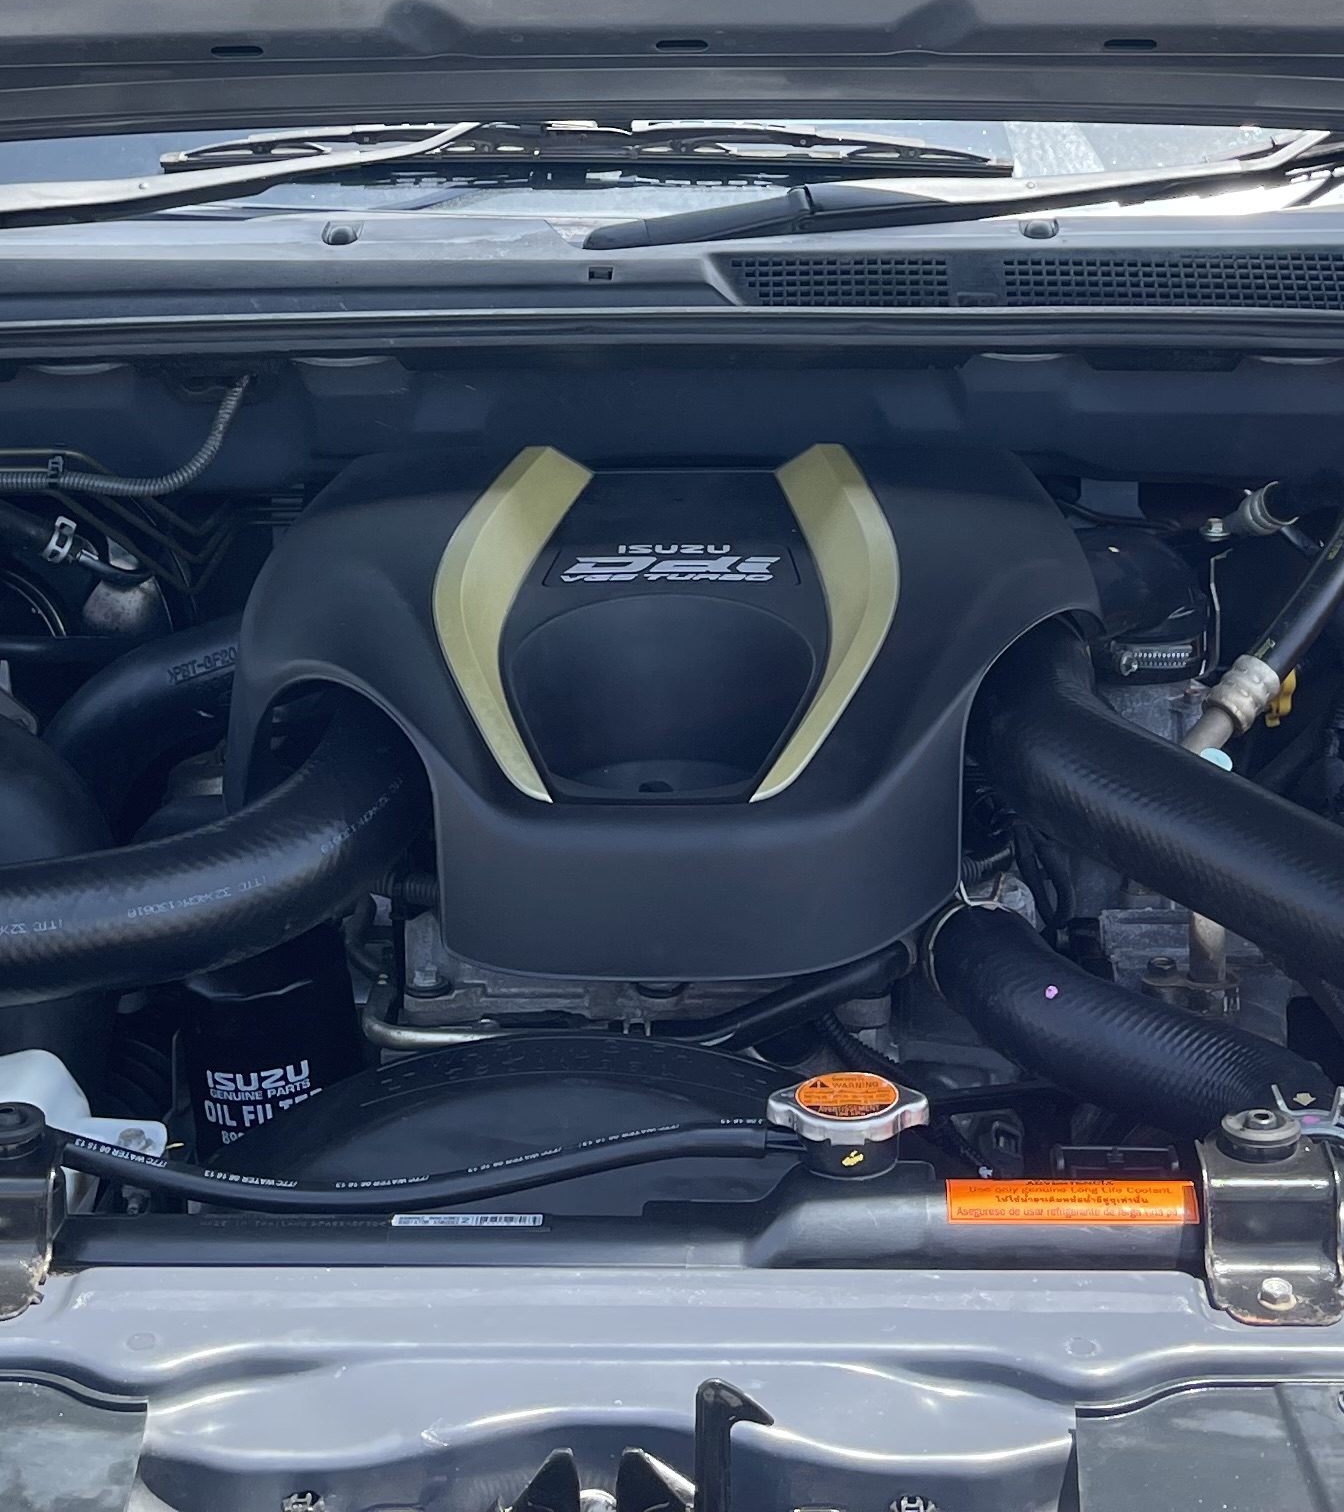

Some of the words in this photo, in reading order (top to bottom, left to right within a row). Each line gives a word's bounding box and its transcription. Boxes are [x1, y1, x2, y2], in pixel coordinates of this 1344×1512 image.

[617, 544, 732, 555] ISUZU
[642, 573, 775, 583] TURBO
[206, 1059, 310, 1092] ISUZU
[209, 1088, 264, 1101] GENUINE
[266, 1077, 311, 1099] PARTS
[203, 1099, 237, 1127] OIL
[112, 1147, 145, 1164] WATER
[242, 1174, 276, 1187] WATER
